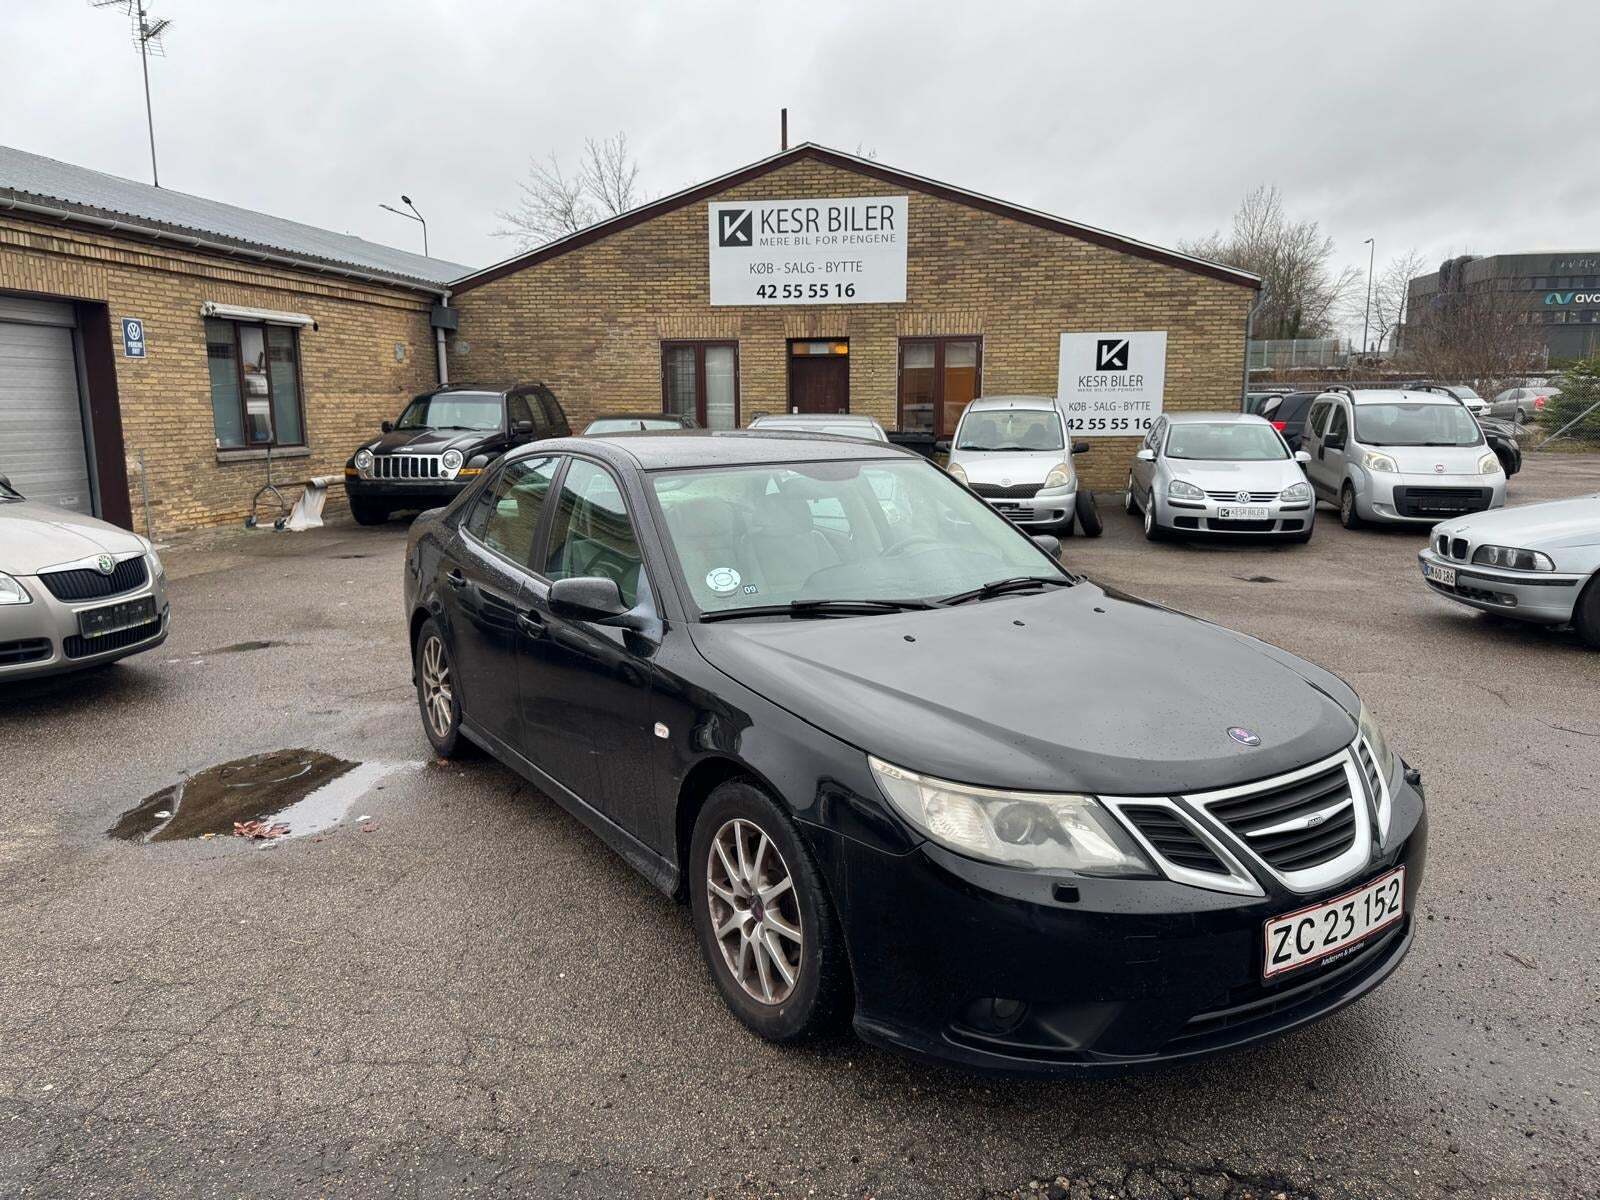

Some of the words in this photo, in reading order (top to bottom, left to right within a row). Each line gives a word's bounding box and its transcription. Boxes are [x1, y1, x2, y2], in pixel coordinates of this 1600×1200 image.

[761, 207, 820, 234] KESR
[828, 205, 895, 232] BILER
[760, 236, 790, 246] MERE
[794, 236, 811, 246] BIL
[815, 235, 838, 245] FOR
[842, 233, 896, 244] PENGENE
[749, 262, 774, 275] KØB
[784, 262, 815, 274] SALG
[825, 260, 863, 273] BYTTE
[756, 284, 777, 299] 42
[782, 284, 803, 299] 55
[808, 283, 829, 298] 55
[834, 283, 856, 298] 16
[1078, 375, 1108, 387] KESR
[1110, 374, 1144, 387] BILER
[1068, 401, 1087, 412] KØB
[1094, 400, 1117, 411] SALG
[1123, 400, 1152, 411] BYTTE
[1067, 418, 1084, 430] 42
[1088, 418, 1106, 430] 55
[1110, 417, 1129, 430] 55
[1134, 417, 1152, 430] 16
[744, 585, 757, 594] 09
[1272, 917, 1316, 965] ZC
[1322, 902, 1356, 946] 23
[1364, 878, 1400, 927] 152
